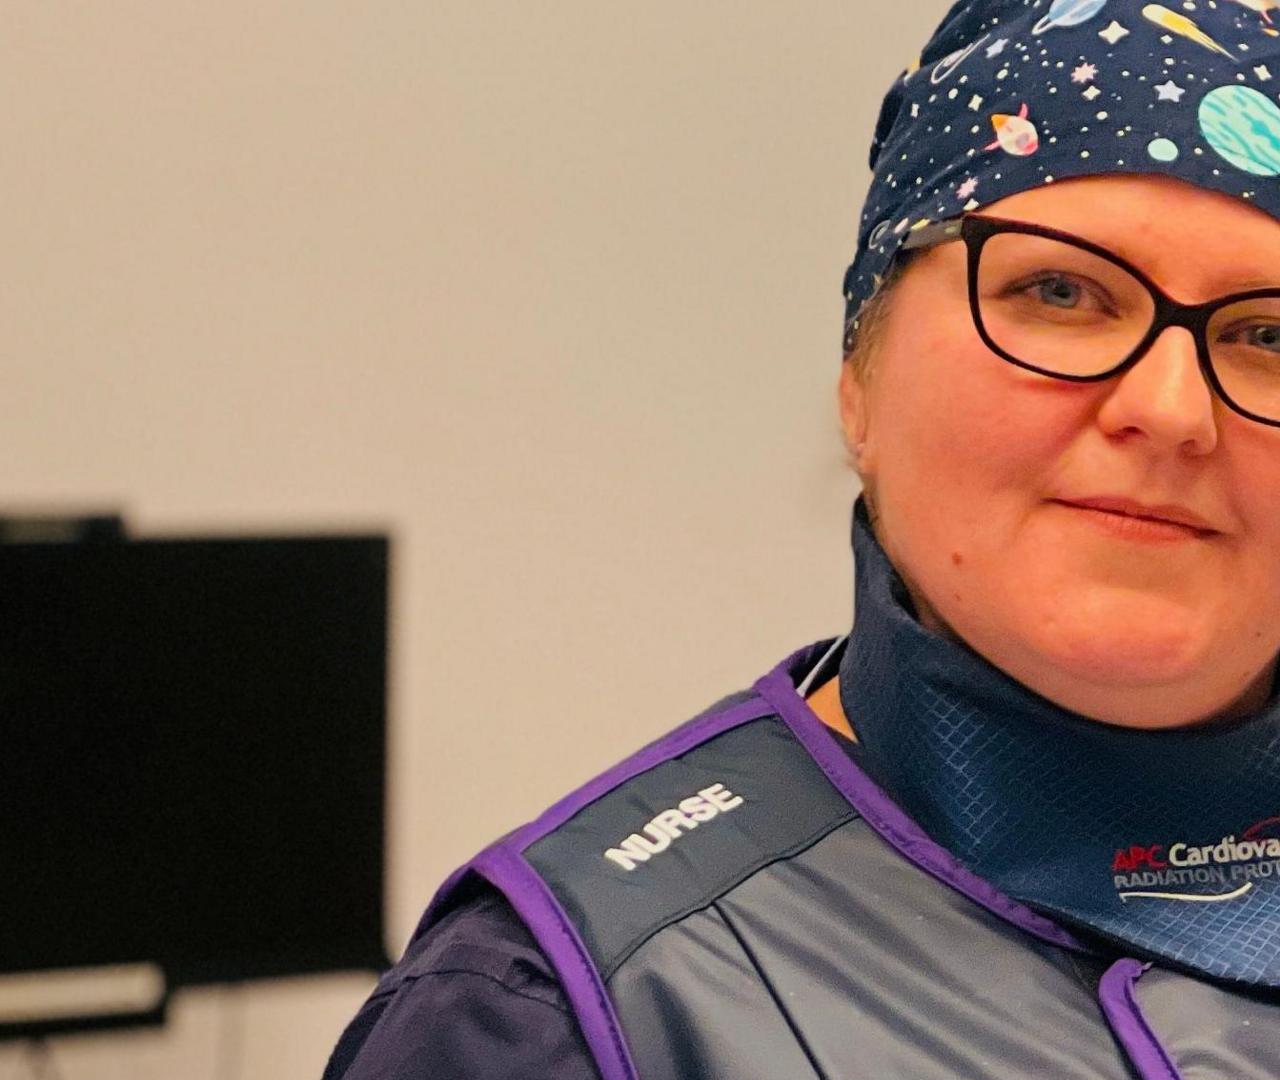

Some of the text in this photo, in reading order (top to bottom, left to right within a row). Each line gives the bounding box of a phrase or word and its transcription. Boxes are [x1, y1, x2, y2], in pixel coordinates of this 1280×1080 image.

[604, 782, 744, 871] NURSE
[1112, 844, 1167, 870] APC
[1114, 864, 1226, 889] RADIATION
